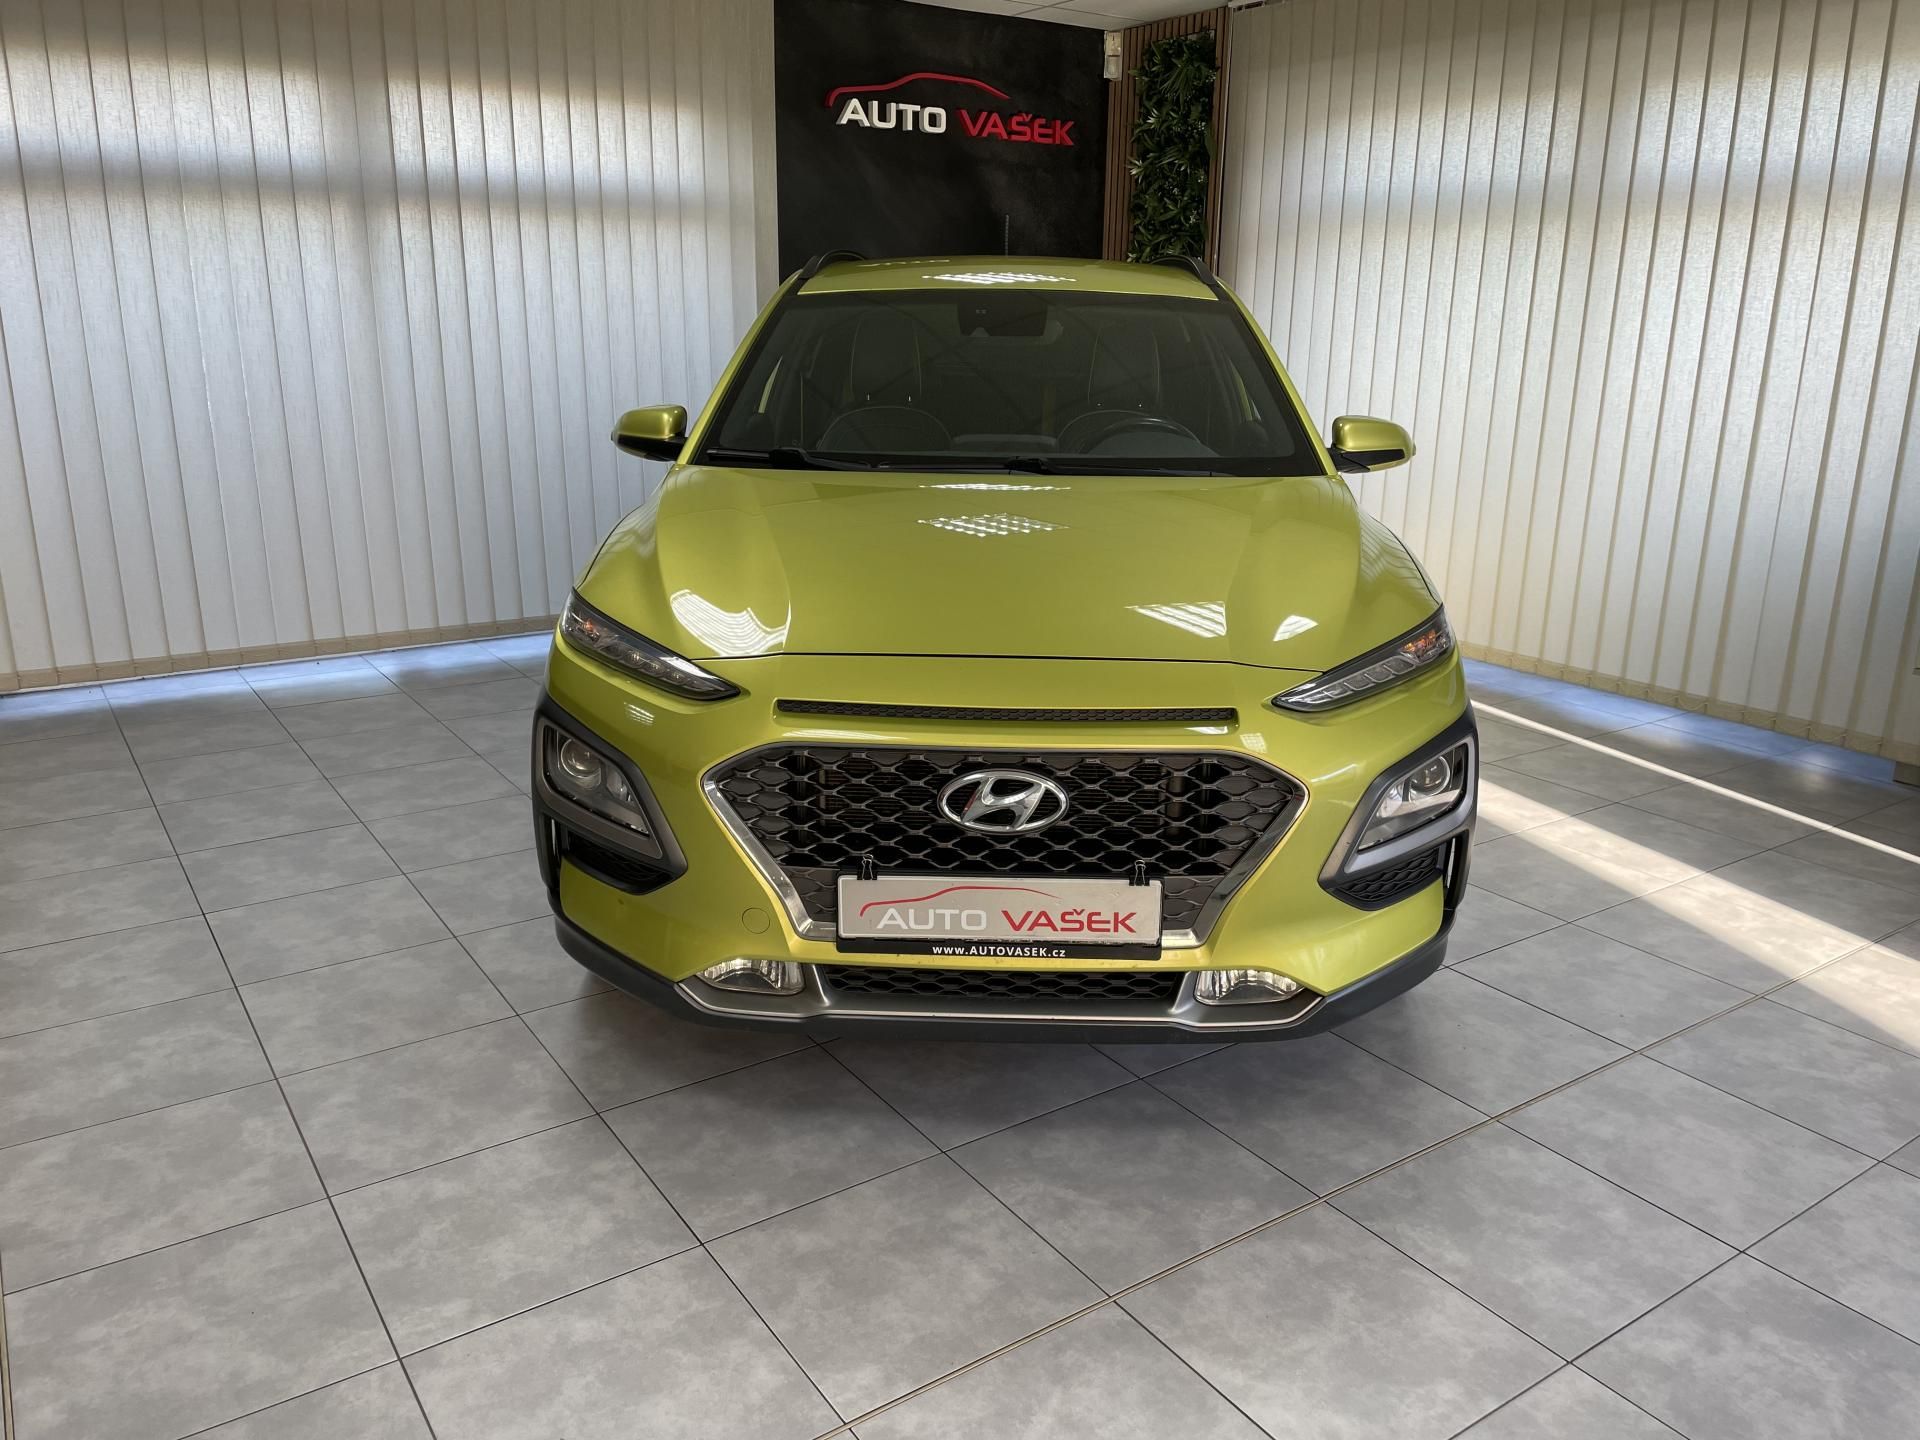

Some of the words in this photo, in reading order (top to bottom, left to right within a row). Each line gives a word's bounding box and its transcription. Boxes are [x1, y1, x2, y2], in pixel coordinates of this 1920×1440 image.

[836, 98, 947, 134] AUTO
[957, 109, 1075, 146] VAŠEK
[876, 907, 988, 931] AUTO
[1000, 907, 1137, 933] VAŠEK
[932, 944, 1067, 958] www.AUTOVASEK.cz
